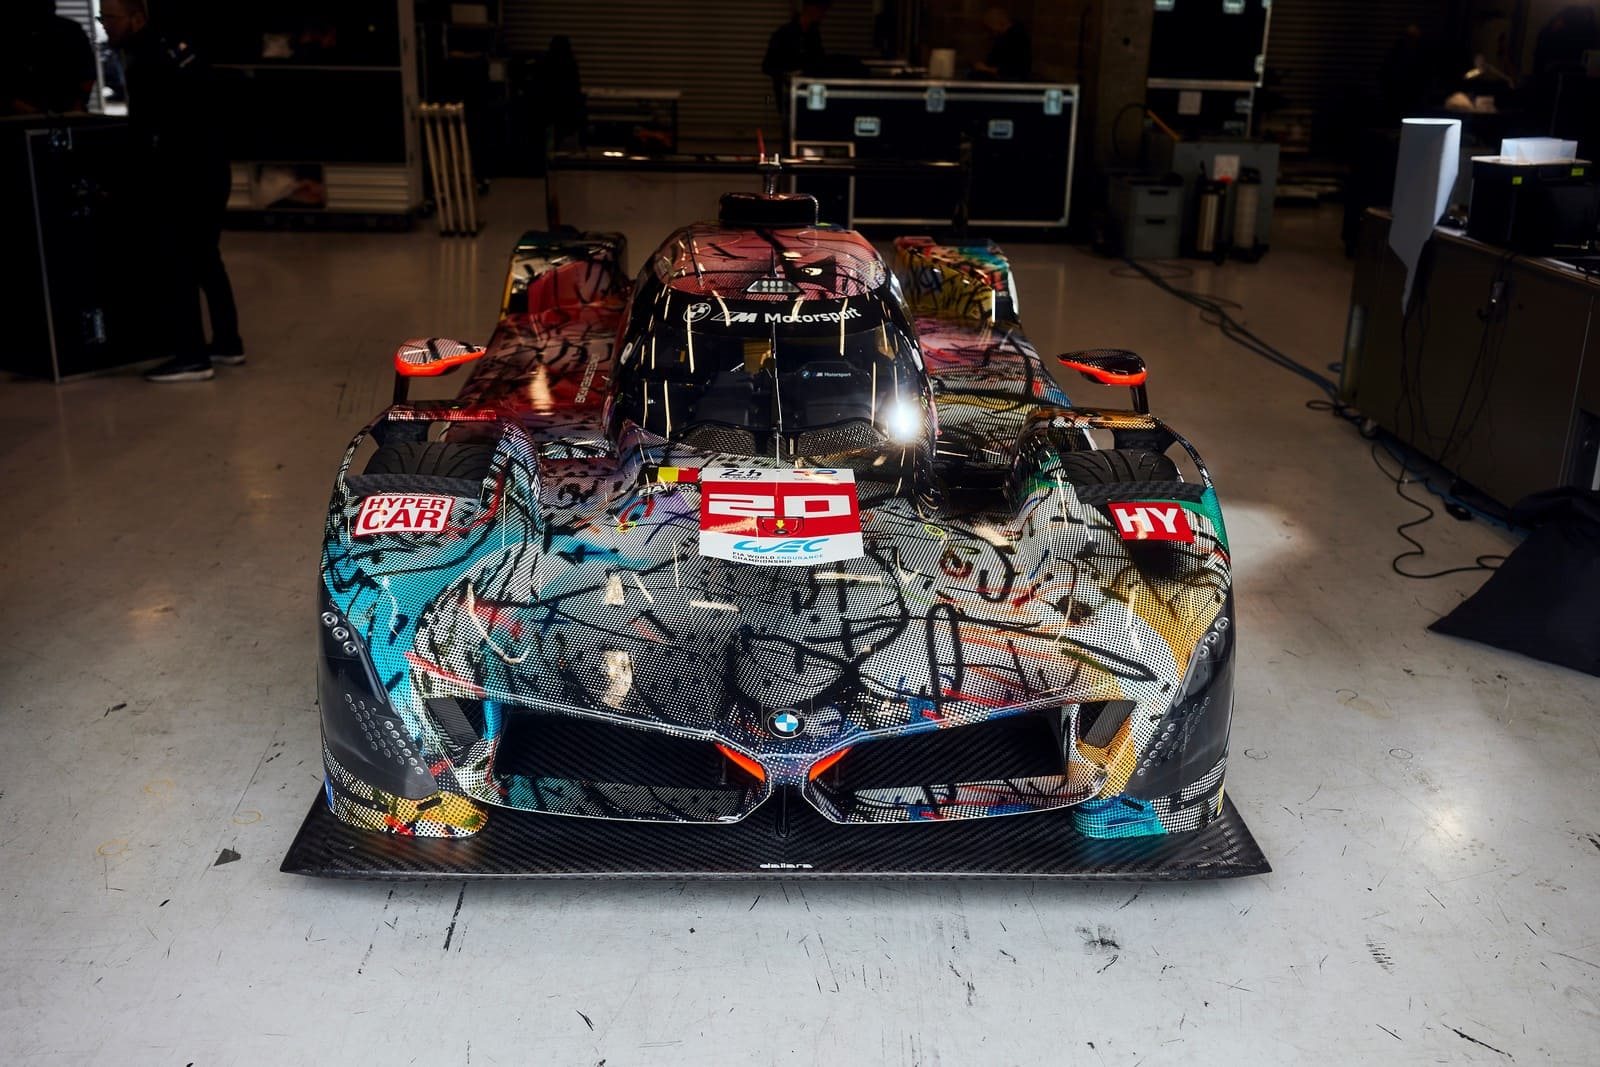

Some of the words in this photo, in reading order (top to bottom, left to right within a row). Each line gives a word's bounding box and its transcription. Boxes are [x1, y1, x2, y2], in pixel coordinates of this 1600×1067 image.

[764, 308, 862, 324] Motorsport
[367, 497, 446, 510] HYPER
[708, 493, 851, 519] 20
[362, 508, 442, 531] CAR
[1114, 507, 1179, 534] HY
[733, 537, 830, 553] WEC
[731, 555, 792, 564] CHAMPIONSHIP
[777, 553, 823, 561] ENDURANCE
